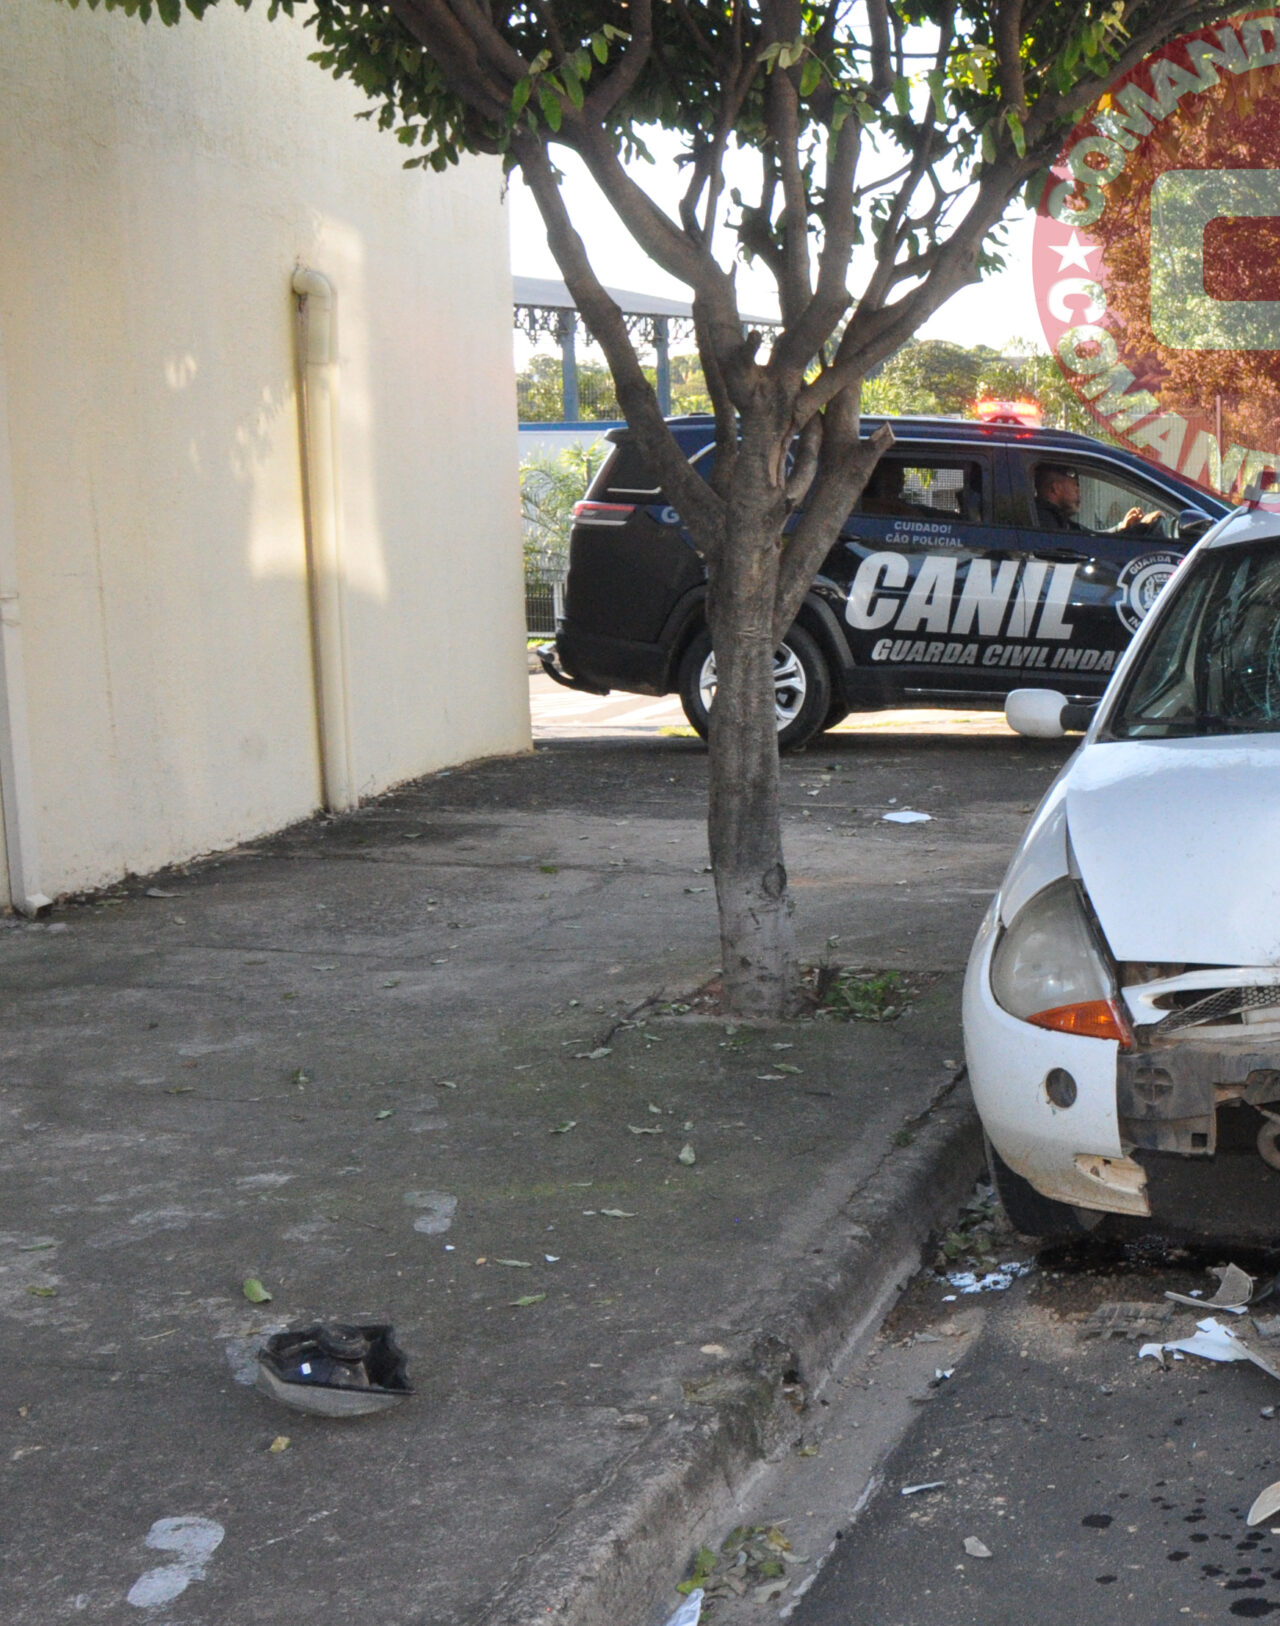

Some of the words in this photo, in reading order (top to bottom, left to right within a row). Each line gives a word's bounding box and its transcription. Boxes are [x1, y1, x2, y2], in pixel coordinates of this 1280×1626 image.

[894, 521, 952, 534] CUIDADO!
[885, 532, 909, 544] CÃO
[912, 535, 964, 547] POLICIAL
[1129, 556, 1171, 575] GUARDA
[845, 551, 1080, 640] CANIL
[871, 639, 979, 665] GUARDA
[982, 644, 1050, 667] CIVIL
